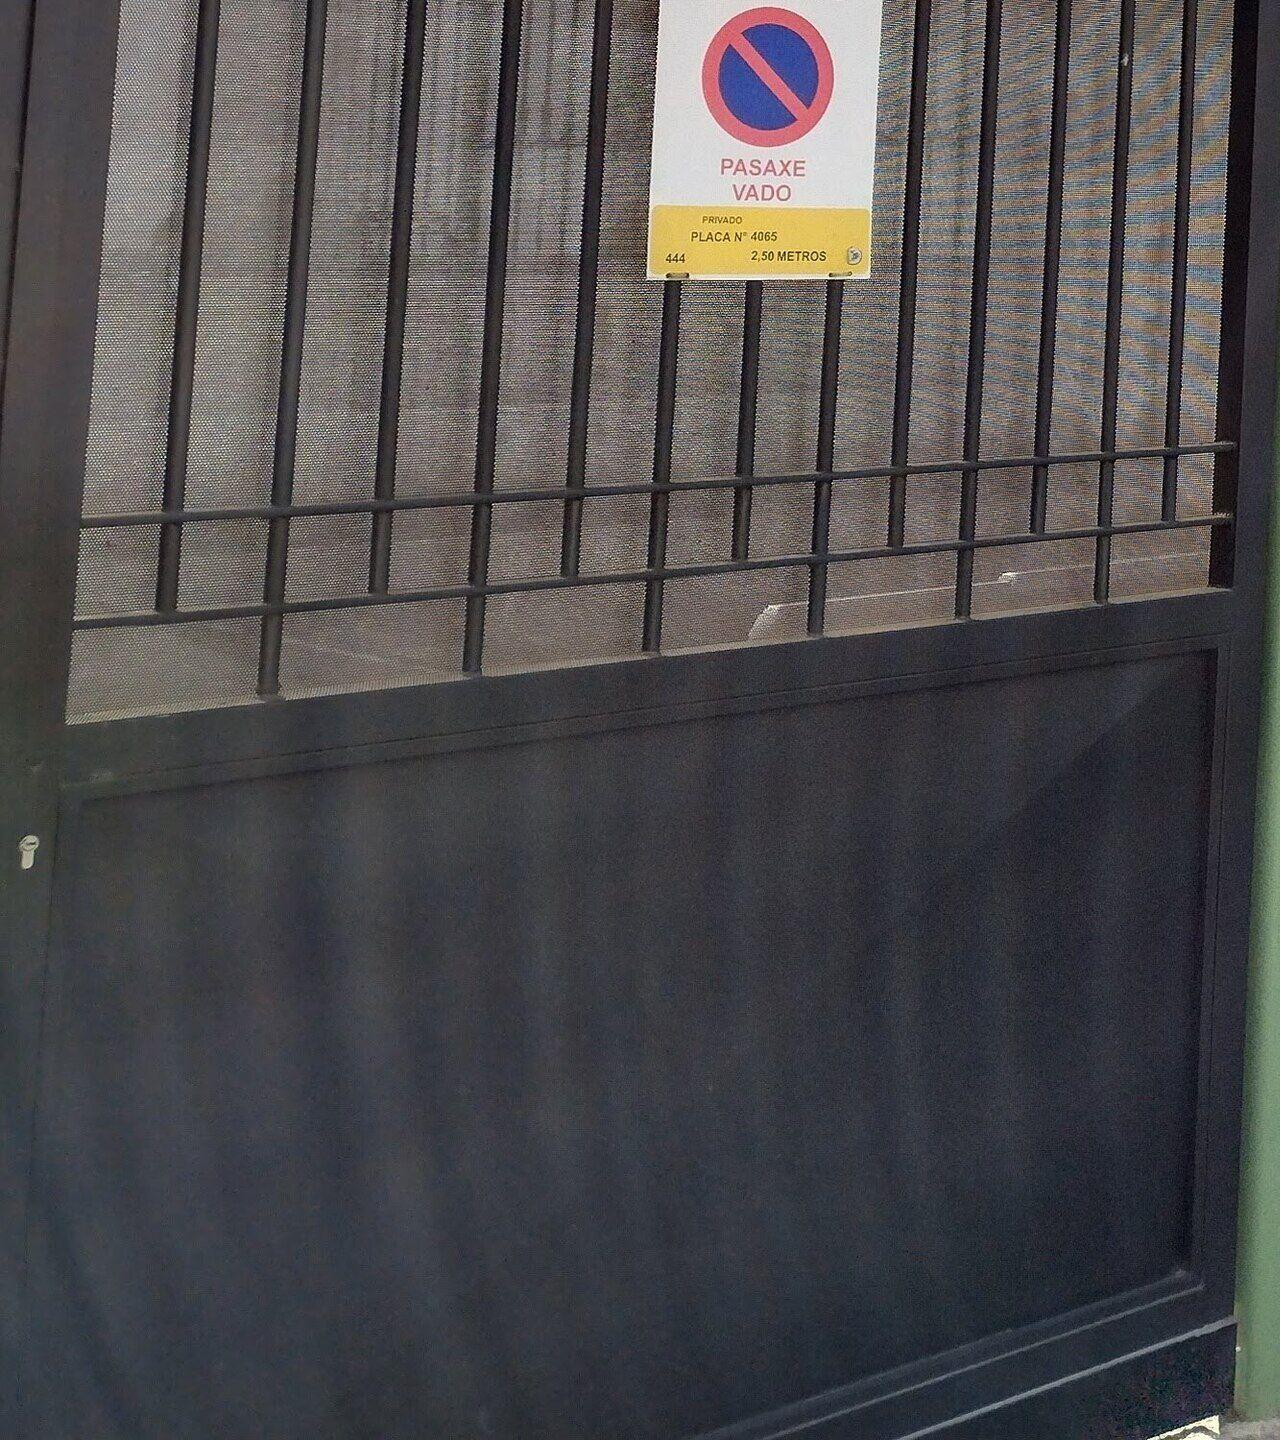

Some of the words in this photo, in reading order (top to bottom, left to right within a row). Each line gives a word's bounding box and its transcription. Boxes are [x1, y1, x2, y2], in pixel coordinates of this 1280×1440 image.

[720, 157, 806, 178] PASAXE
[732, 183, 792, 202] VADO
[702, 215, 743, 225] PRIVADO
[691, 231, 731, 242] PLACA
[750, 231, 778, 242] 4065
[665, 253, 686, 263] 444
[750, 250, 775, 262] 2,50
[777, 250, 827, 262] METROS
